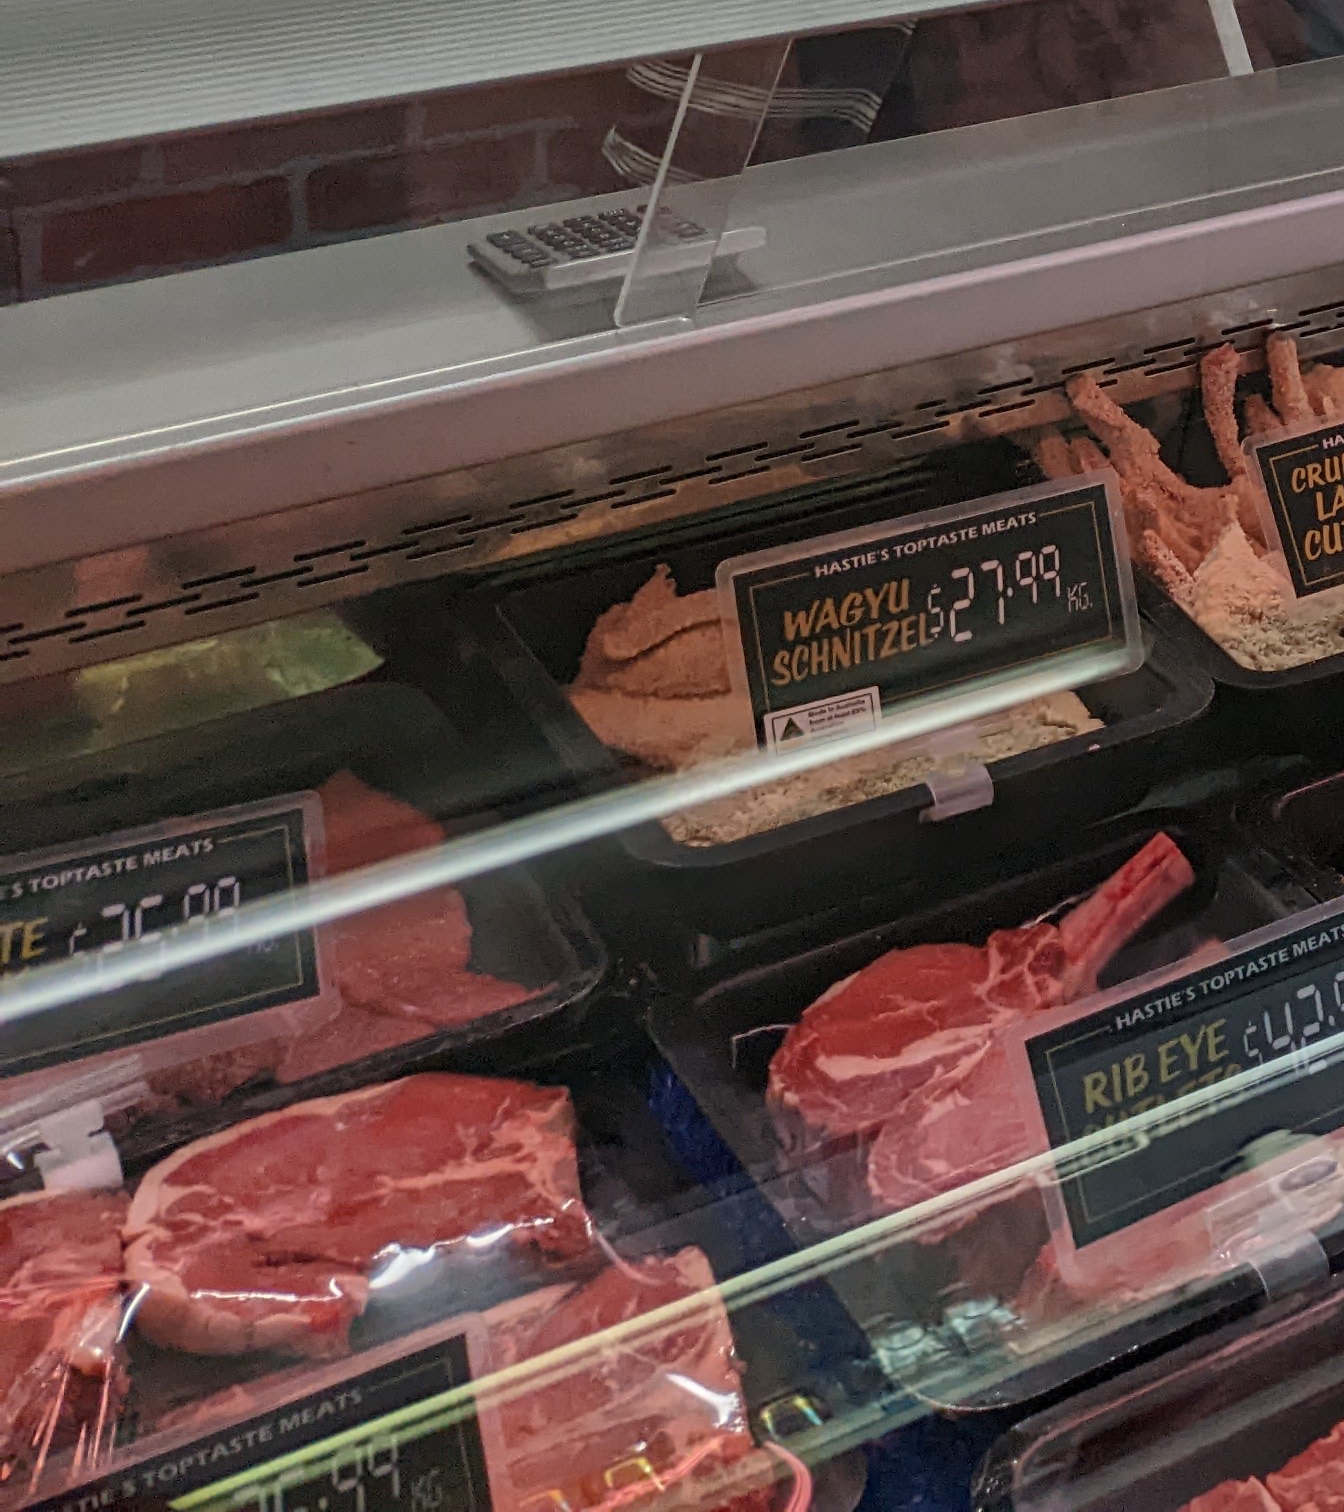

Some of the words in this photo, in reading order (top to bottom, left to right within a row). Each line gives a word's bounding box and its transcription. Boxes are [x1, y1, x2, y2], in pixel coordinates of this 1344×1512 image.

[814, 548, 890, 578] HASTIE'S
[894, 527, 978, 560] TOPTASTE
[783, 579, 909, 642] WAGYU
[928, 545, 1060, 642] $27.99
[772, 612, 934, 686] SCHNITZEL
[143, 839, 213, 868] MEATS
[1115, 986, 1196, 1031] HASTIE'S
[1198, 949, 1290, 996] TOPTASTE
[1082, 1053, 1149, 1115] RIB
[1158, 1018, 1231, 1087] EYE
